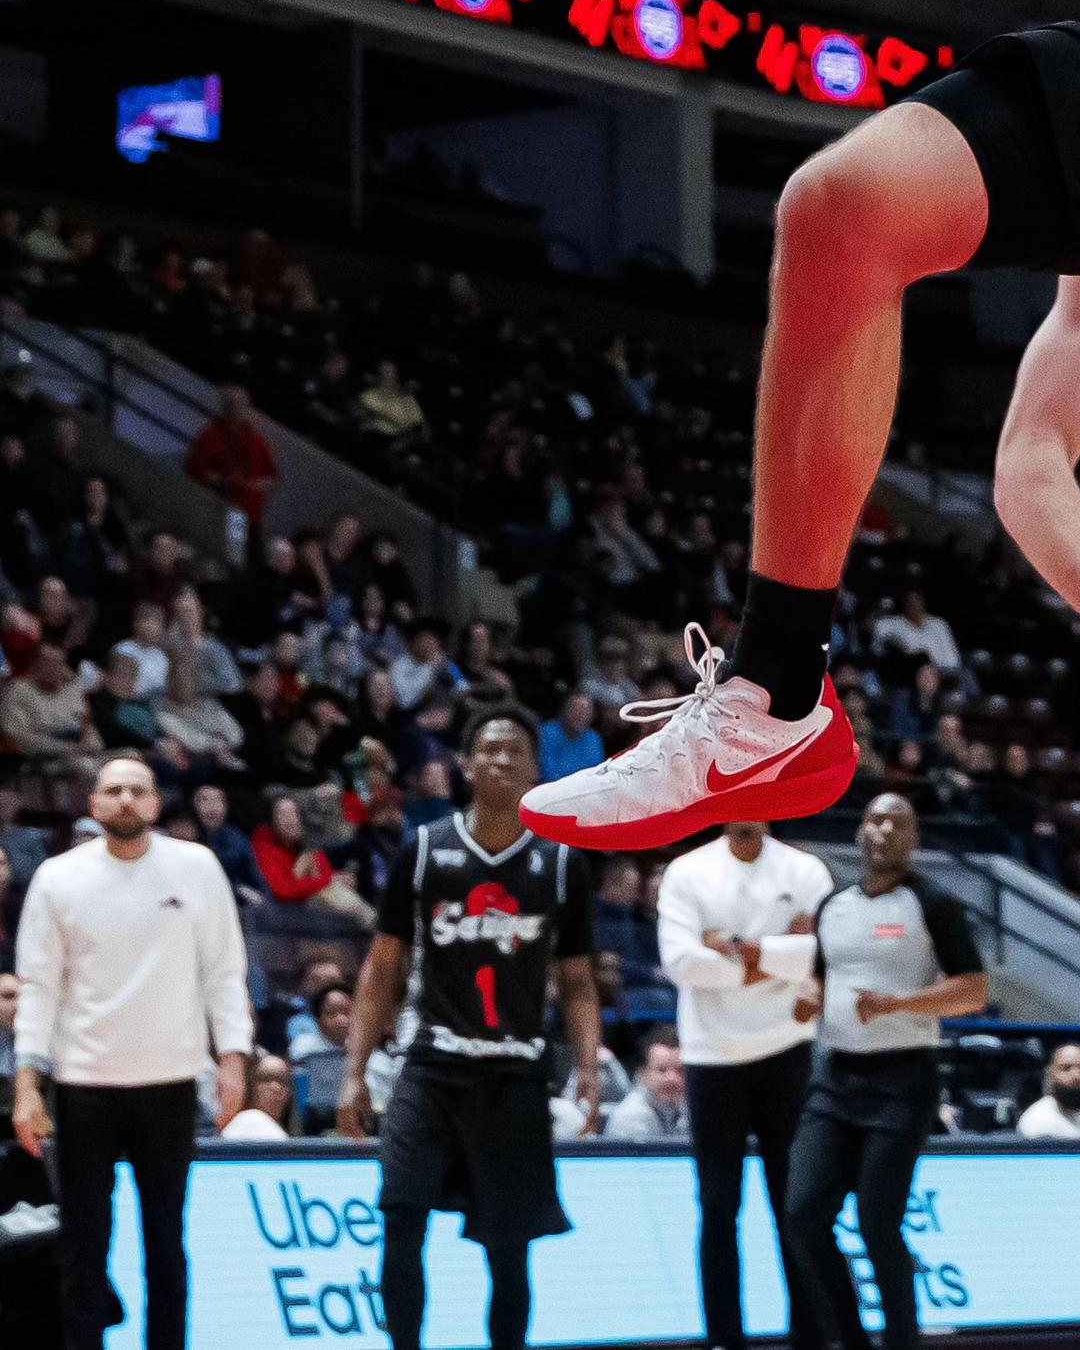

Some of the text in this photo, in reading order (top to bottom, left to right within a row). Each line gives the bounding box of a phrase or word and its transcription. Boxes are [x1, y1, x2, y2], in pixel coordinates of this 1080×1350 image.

[475, 965, 499, 1028] 1
[248, 1181, 382, 1248] Ube
[272, 1267, 386, 1337] Eat
